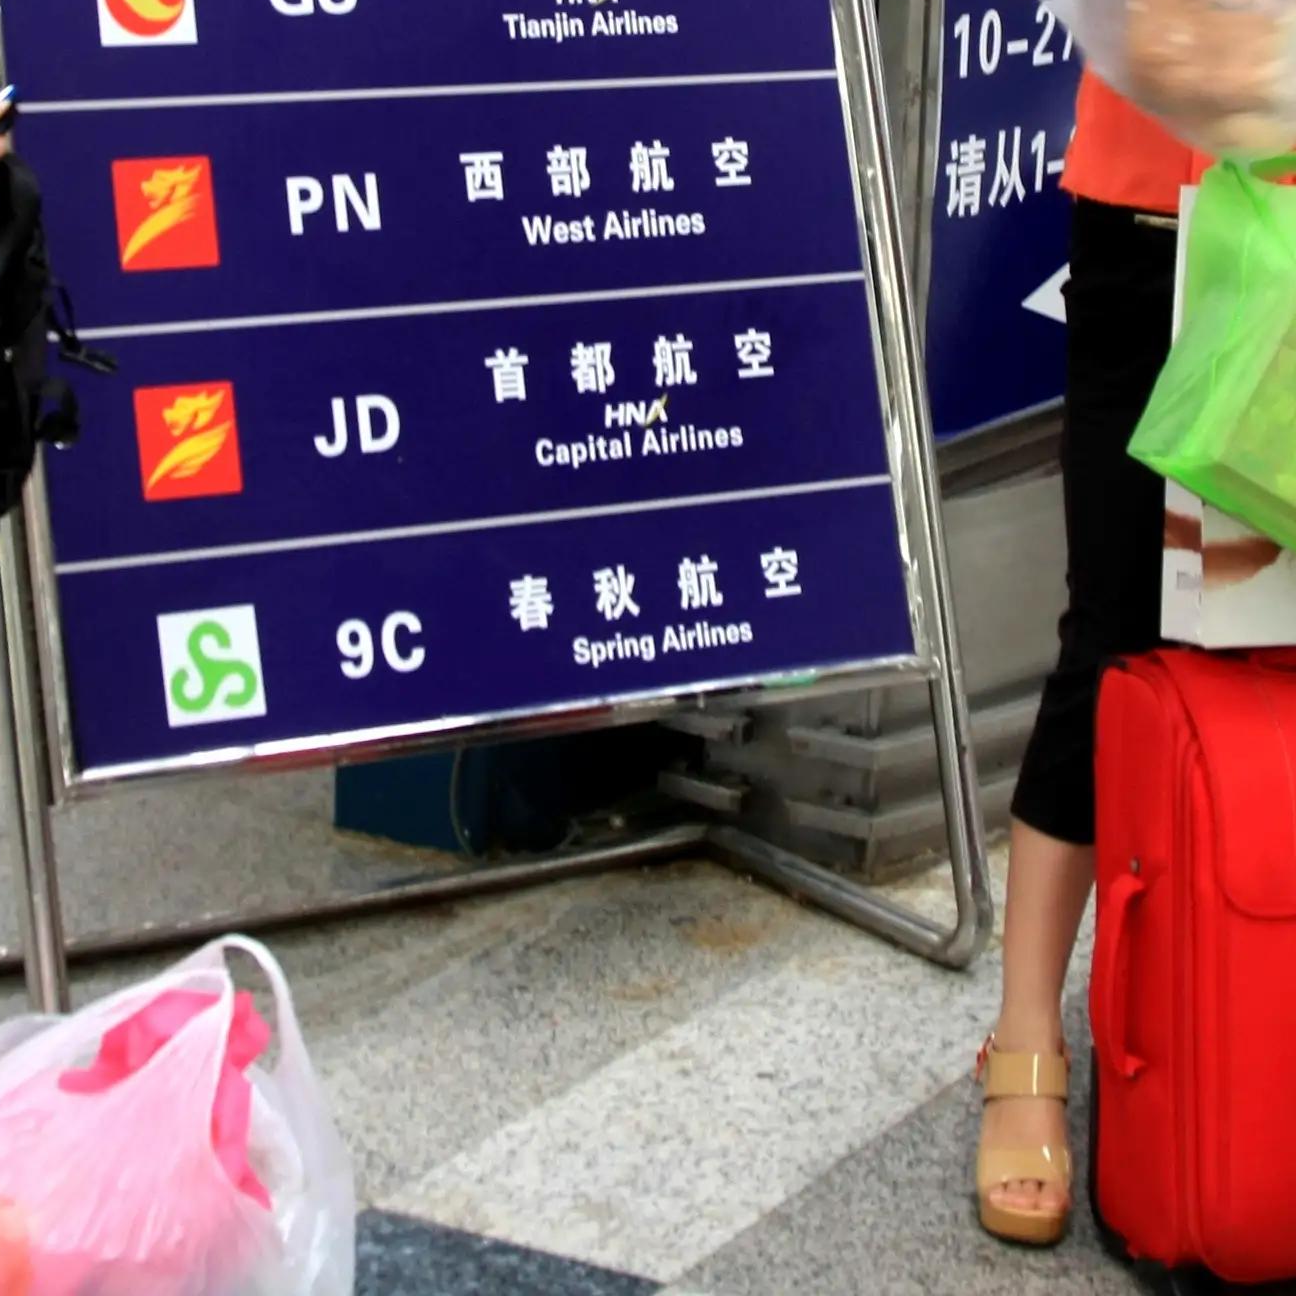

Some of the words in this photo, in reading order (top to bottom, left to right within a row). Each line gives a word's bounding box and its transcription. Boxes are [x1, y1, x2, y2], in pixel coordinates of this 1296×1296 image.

[502, 11, 585, 43] Tianjin
[591, 9, 679, 37] Airlines
[459, 136, 752, 202] 西部航空
[946, 126, 1077, 217] 请从1-
[285, 172, 382, 236] PN
[521, 214, 596, 246] West
[603, 208, 706, 241] Airlines
[484, 328, 775, 404] 首都航空
[313, 394, 401, 458] JD
[604, 395, 668, 428] HNA
[535, 431, 632, 470] Capital
[640, 422, 744, 456] Airlines
[509, 546, 802, 632] 春秋航空
[336, 611, 426, 679] 9C
[572, 633, 656, 669] Spring
[662, 621, 753, 653] Airlines
